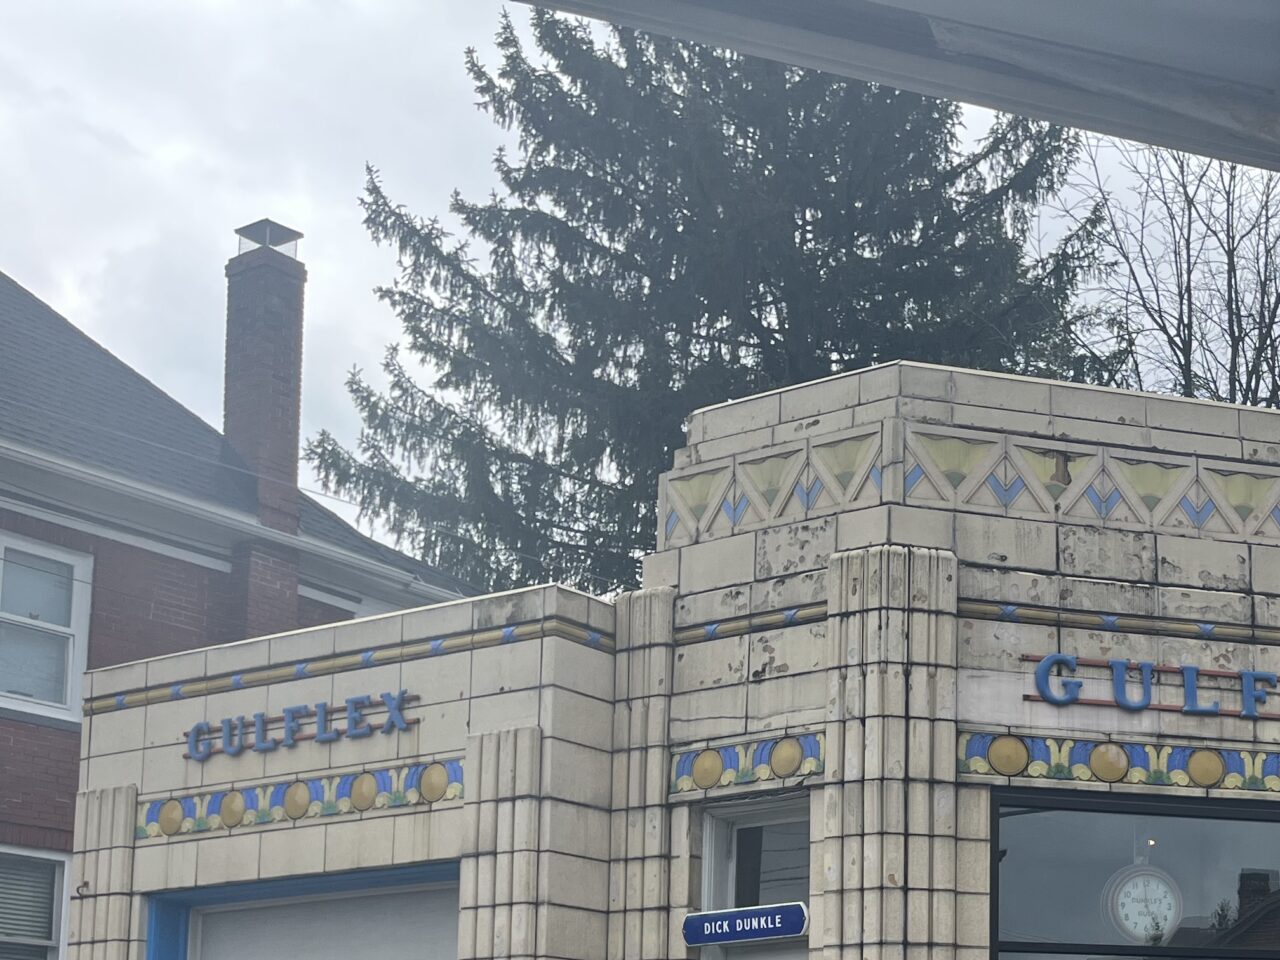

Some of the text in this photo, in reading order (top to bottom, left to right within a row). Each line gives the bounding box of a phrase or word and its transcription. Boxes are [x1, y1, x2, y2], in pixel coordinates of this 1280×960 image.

[1035, 653, 1277, 720] GULF
[187, 688, 408, 762] GULFLEX
[1124, 891, 1131, 899] 10
[1163, 890, 1168, 899] 2
[1120, 901, 1126, 911] 9
[1167, 902, 1172, 911] 3
[1124, 913, 1130, 921] 8
[704, 915, 782, 935] DICK DUNKLE
[1143, 924, 1149, 933] 6
